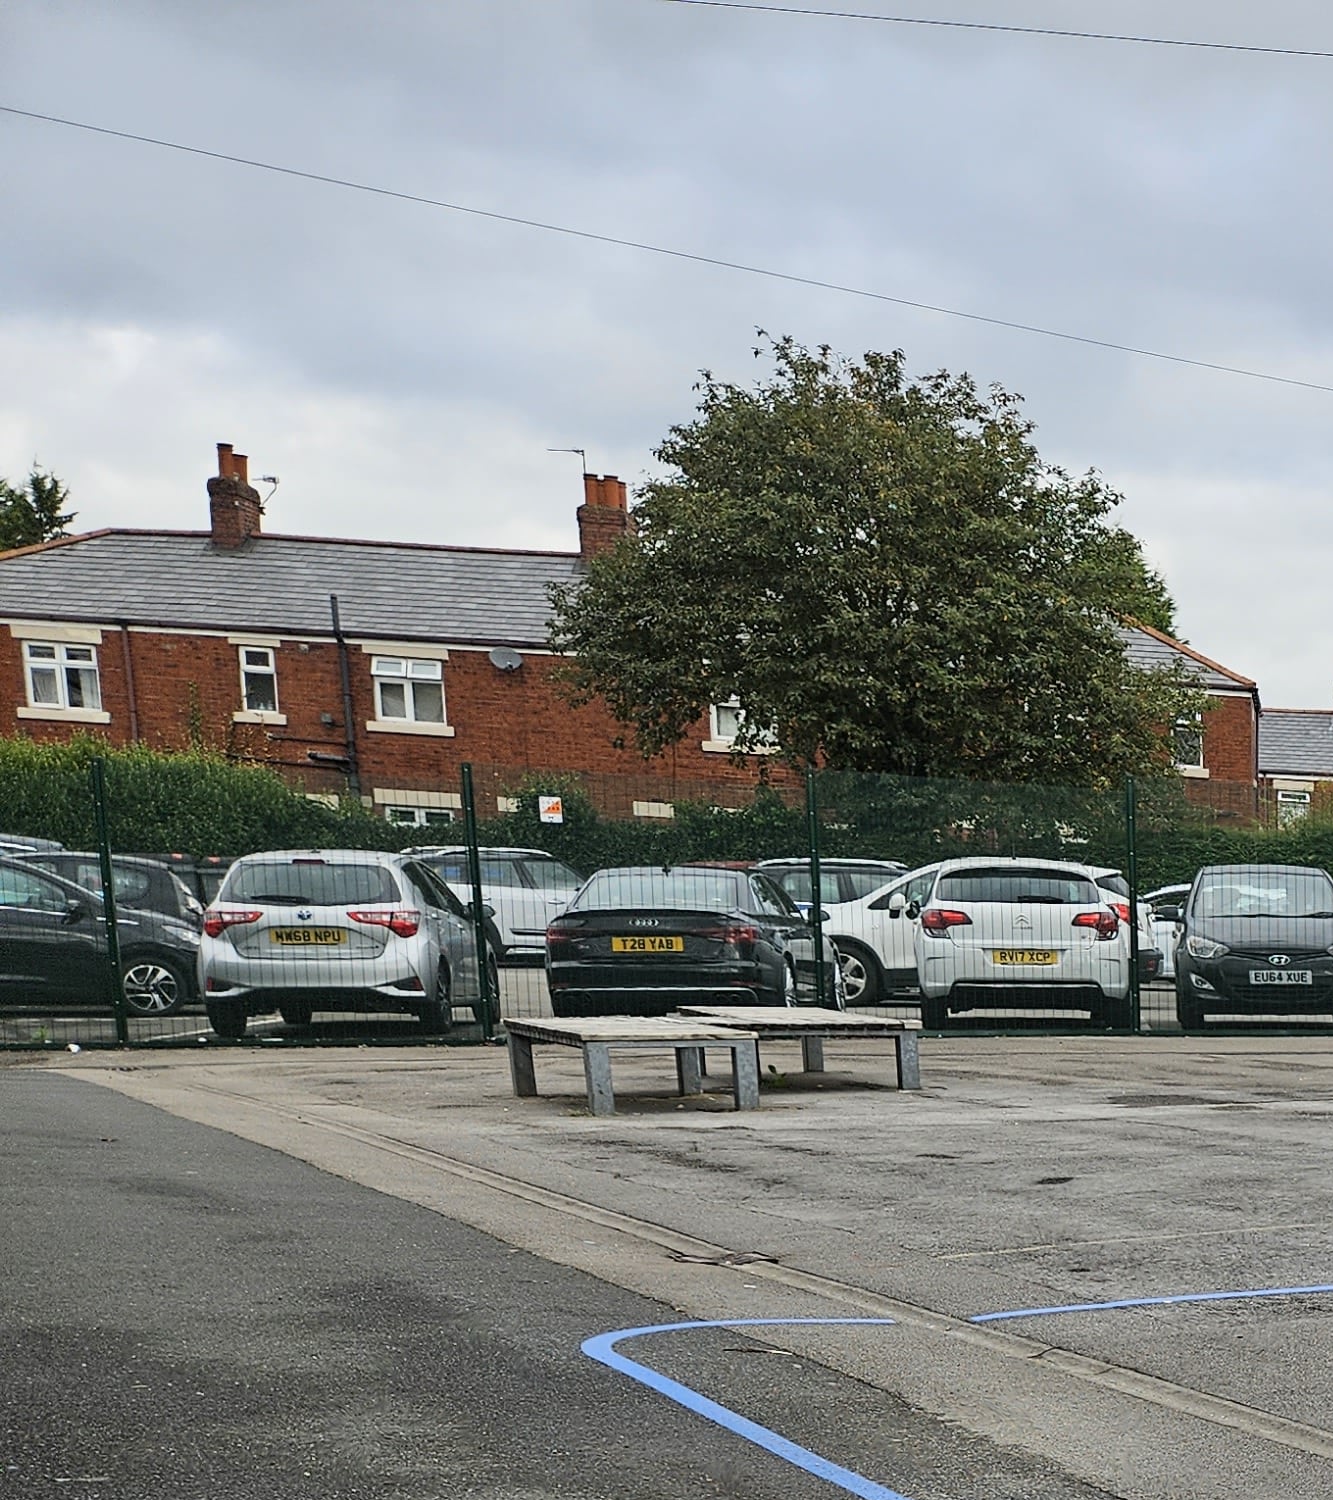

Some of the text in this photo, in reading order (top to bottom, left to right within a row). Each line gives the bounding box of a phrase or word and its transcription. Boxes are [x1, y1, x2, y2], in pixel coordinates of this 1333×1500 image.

[314, 929, 341, 942] NPU
[649, 938, 674, 950] YAB
[1000, 951, 1051, 962] RV17 XCP
[1254, 971, 1308, 983] EU64 XUE
